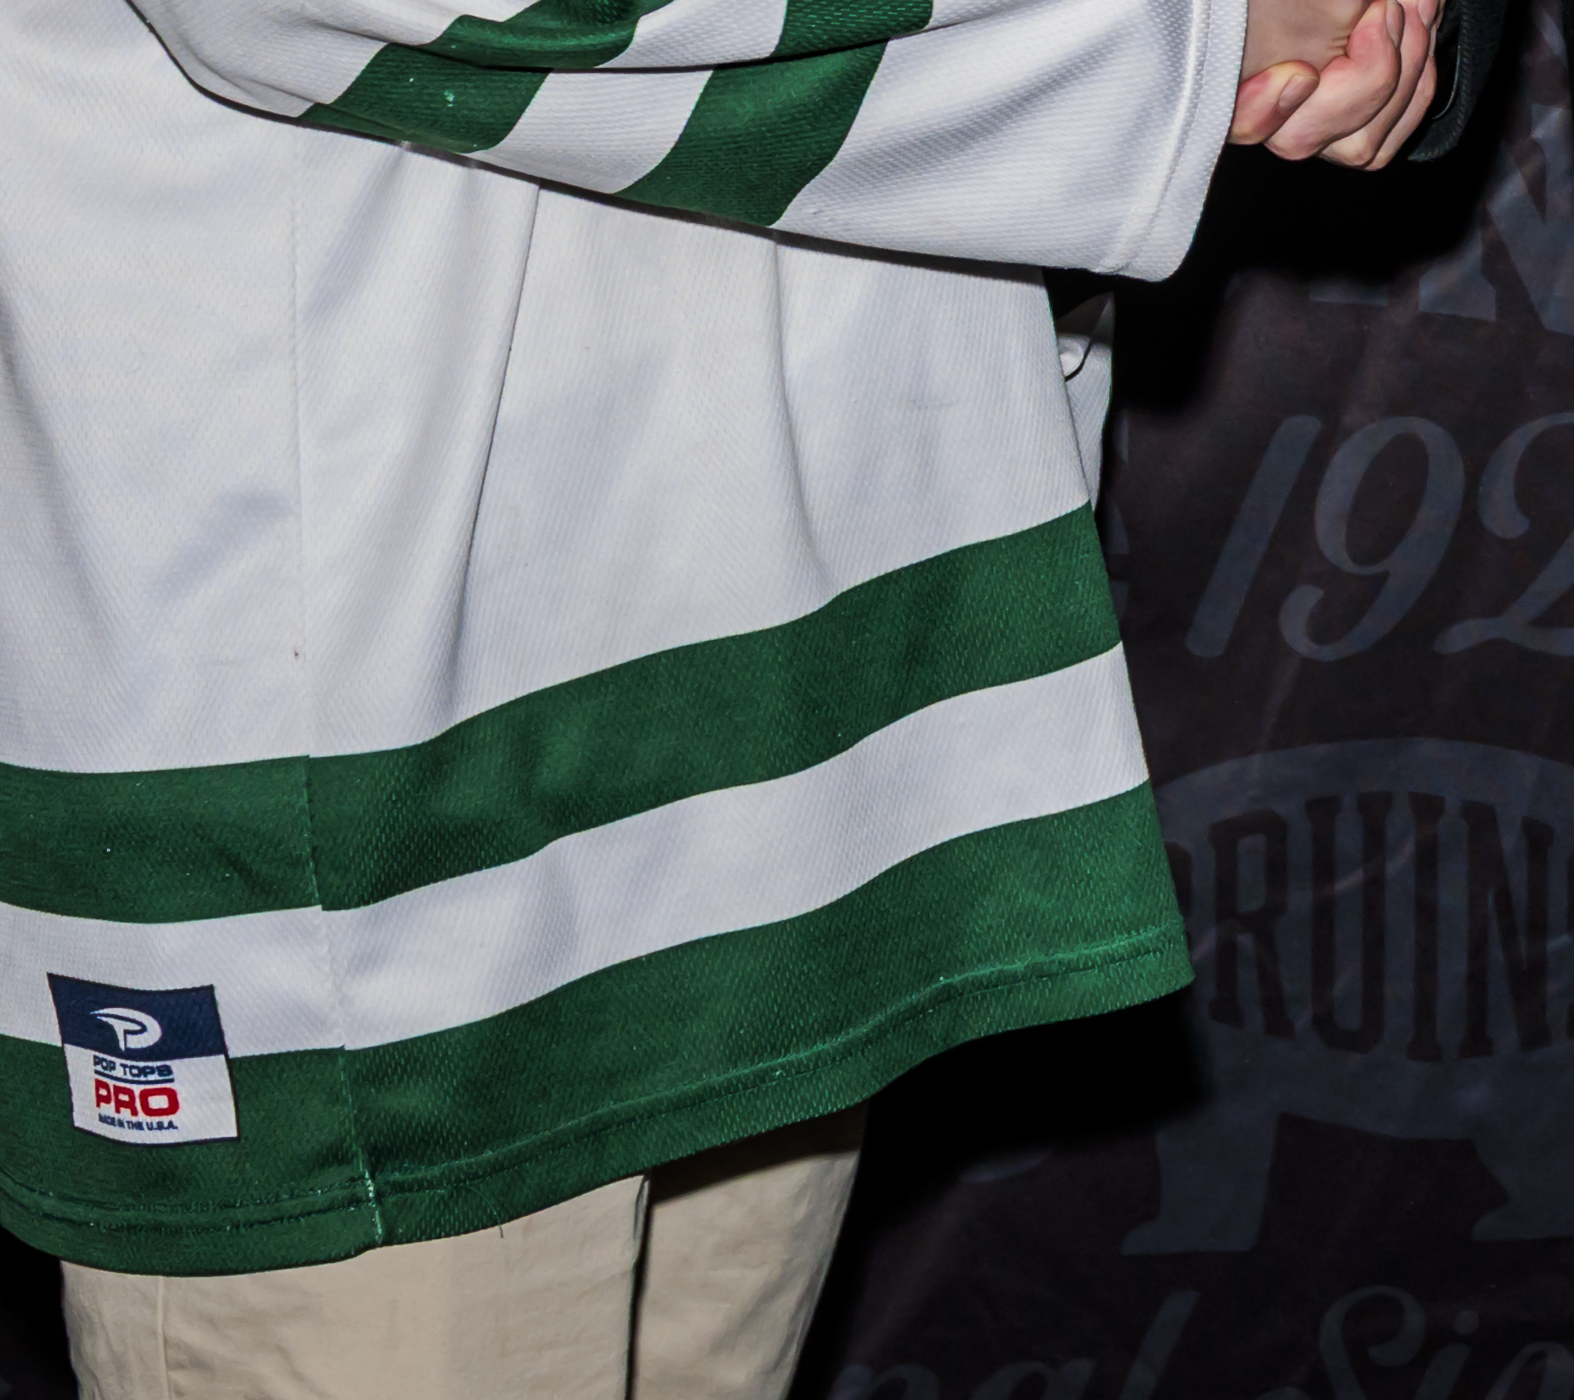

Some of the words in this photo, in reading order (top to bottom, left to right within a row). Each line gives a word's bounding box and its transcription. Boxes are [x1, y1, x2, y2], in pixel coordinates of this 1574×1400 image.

[92, 1054, 117, 1073] POP
[119, 1062, 174, 1079] TOPS
[94, 1077, 181, 1118] PRO
